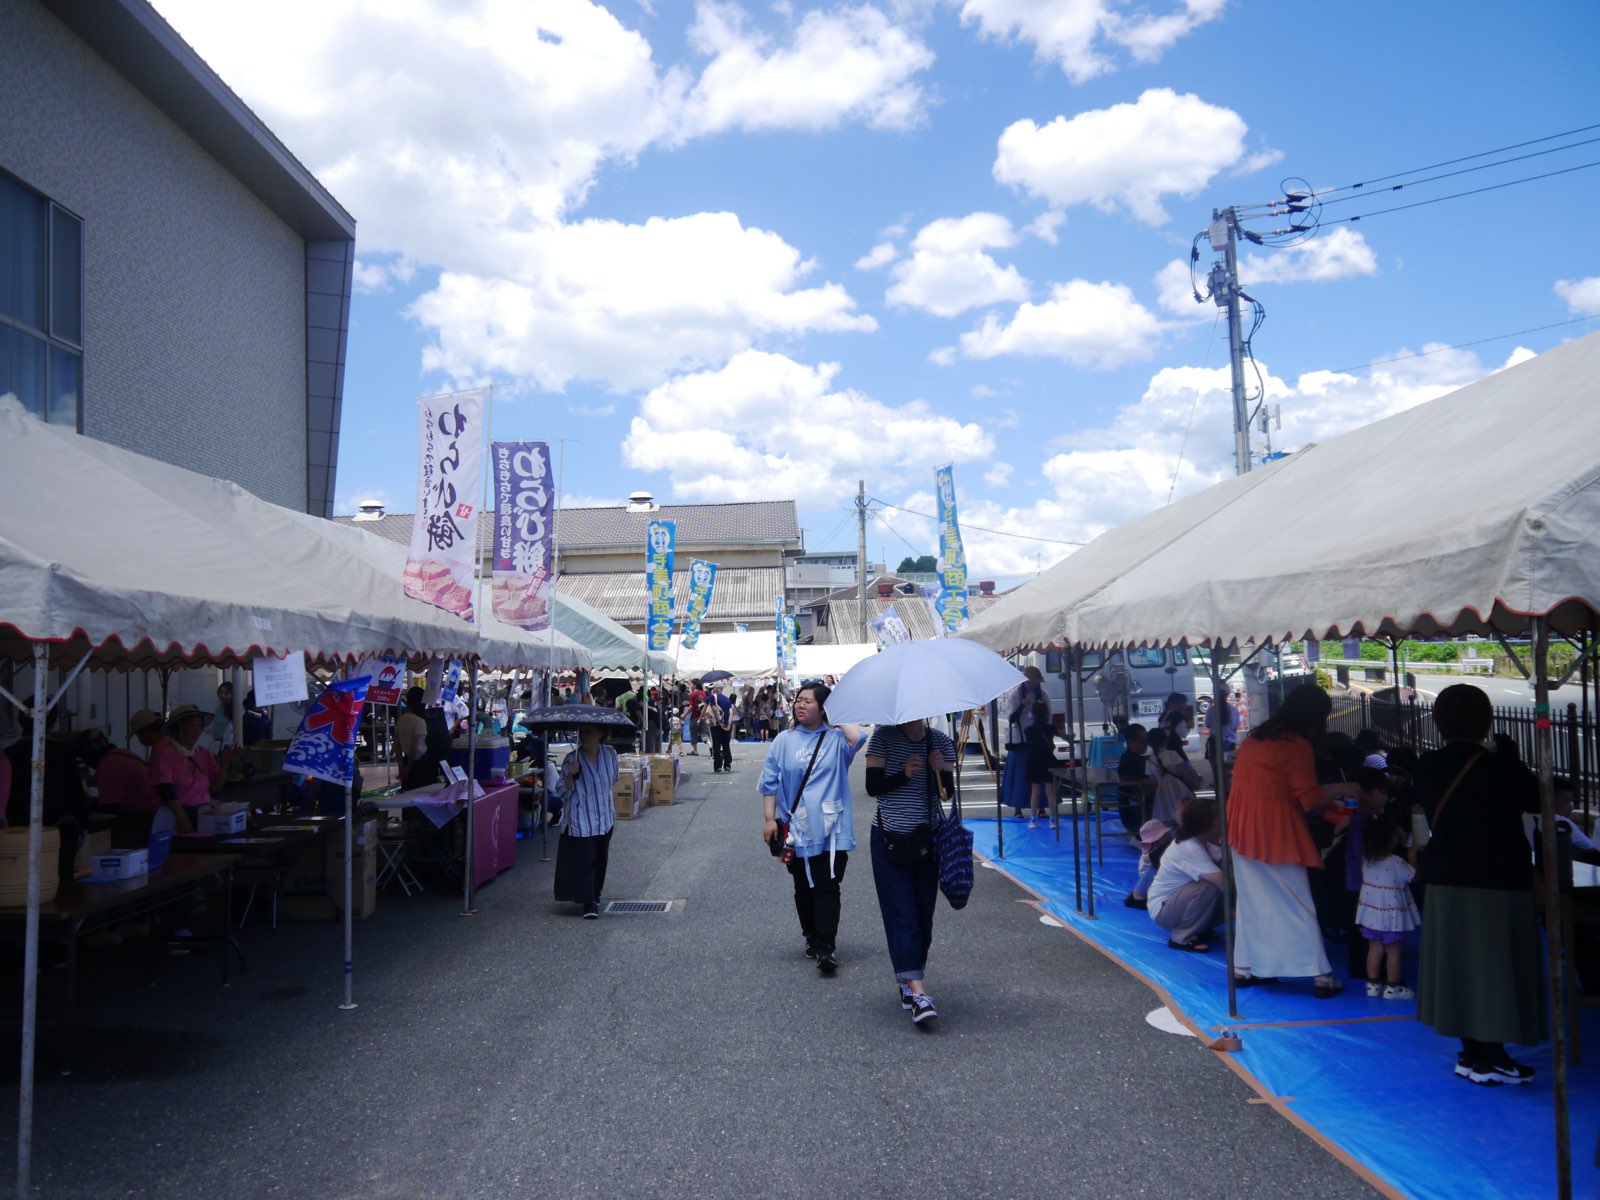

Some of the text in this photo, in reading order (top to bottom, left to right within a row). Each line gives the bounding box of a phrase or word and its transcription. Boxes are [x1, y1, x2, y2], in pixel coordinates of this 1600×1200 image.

[653, 551, 670, 648] 宇美町商工会
[942, 509, 966, 627] 宇美町商工会
